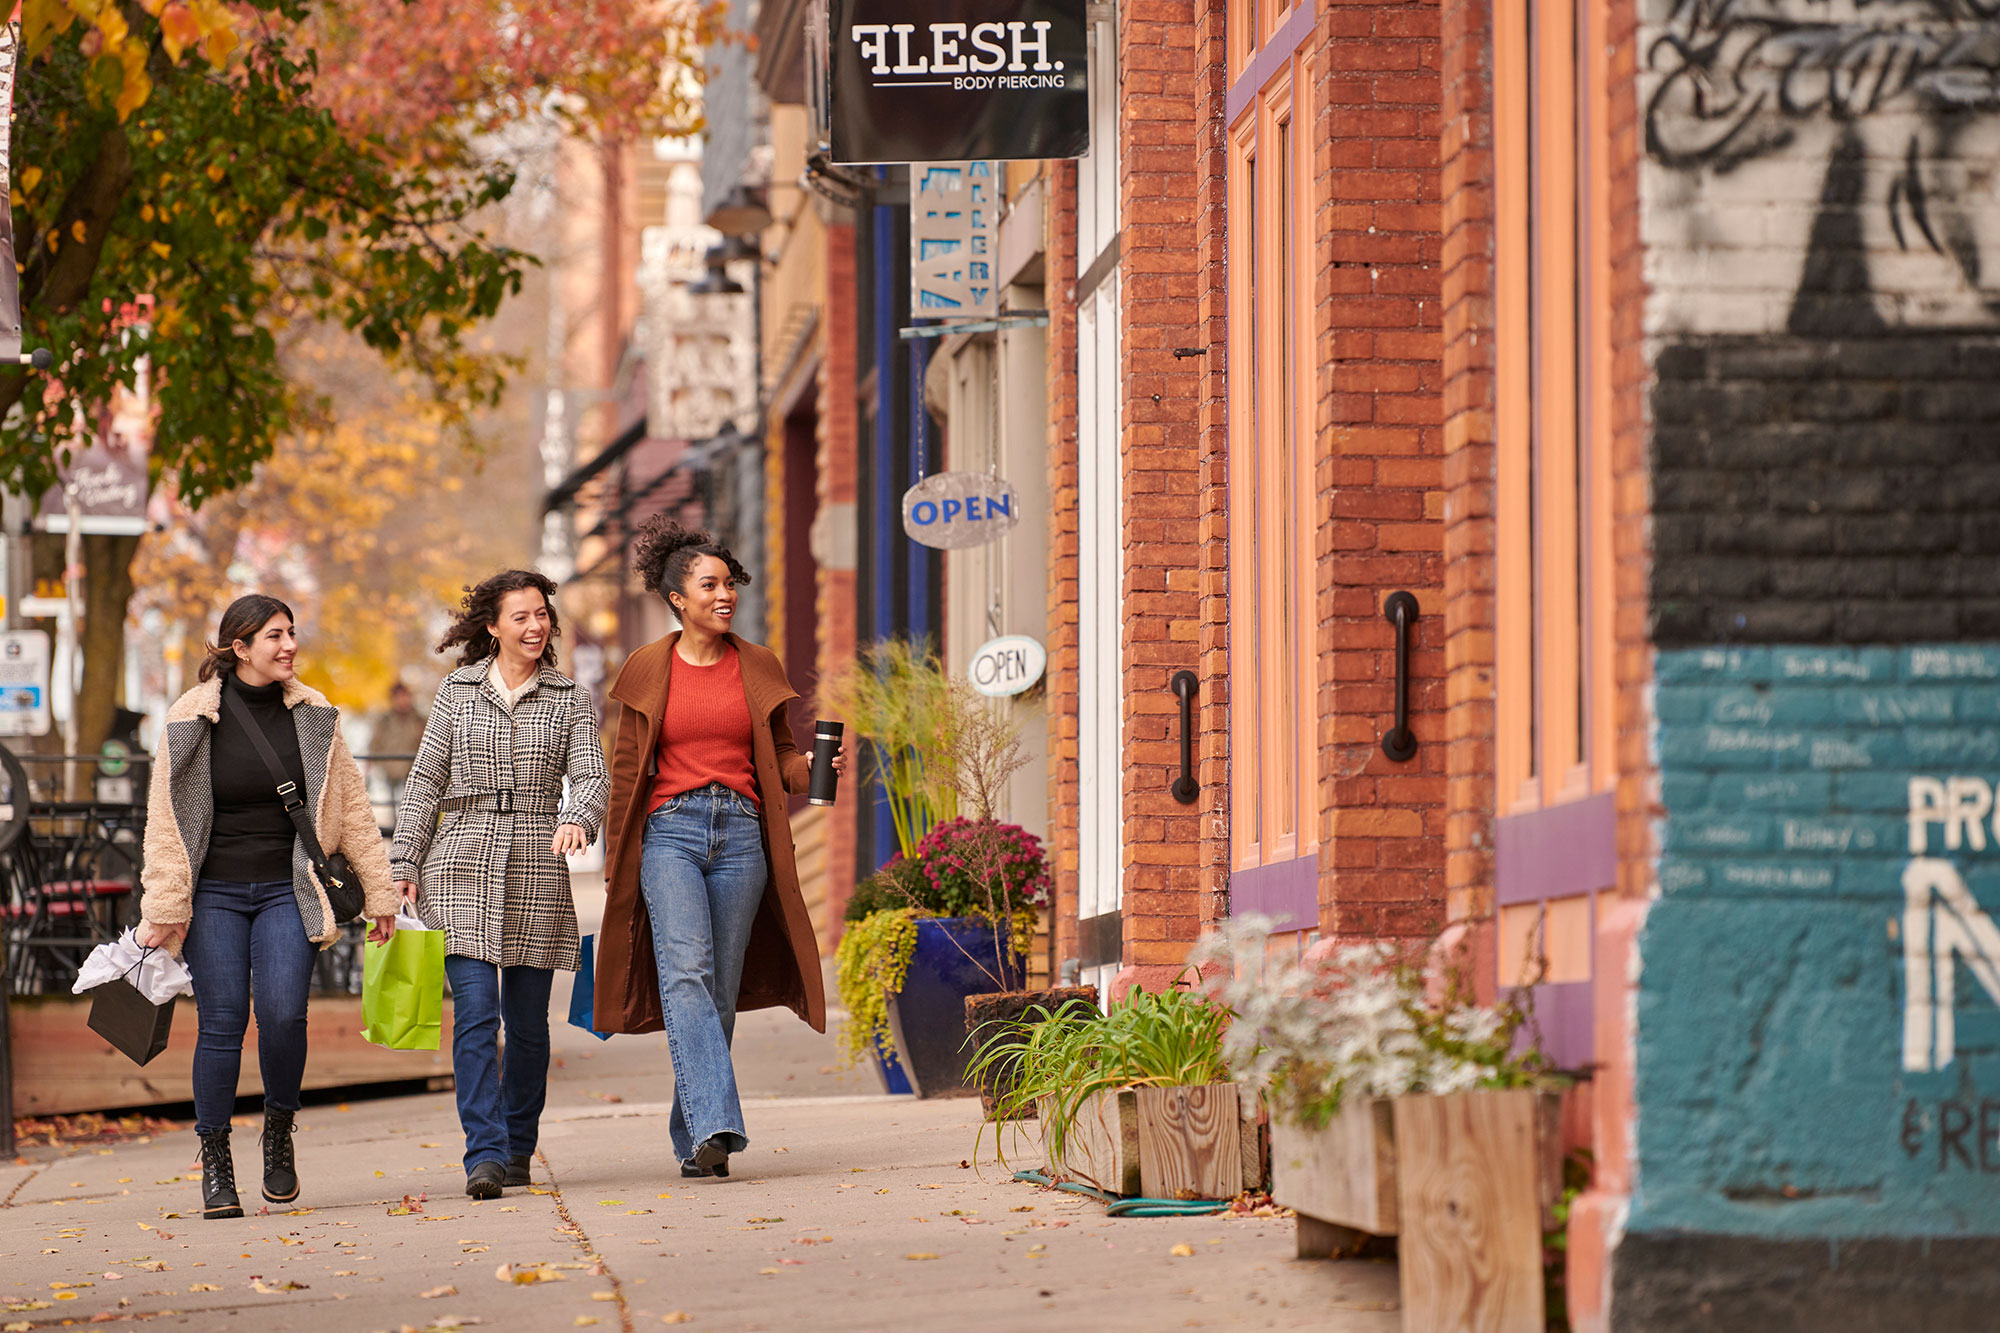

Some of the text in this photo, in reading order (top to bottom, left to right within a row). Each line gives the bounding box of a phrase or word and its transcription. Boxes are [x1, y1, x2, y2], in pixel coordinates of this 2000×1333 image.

[851, 20, 1065, 75] FLESH.
[953, 74, 1065, 90] BODY PIERCING
[968, 160, 991, 306] ALLERY
[911, 494, 1011, 526] OPEN
[975, 649, 1027, 685] OPEN
[1907, 776, 2000, 855] PR
